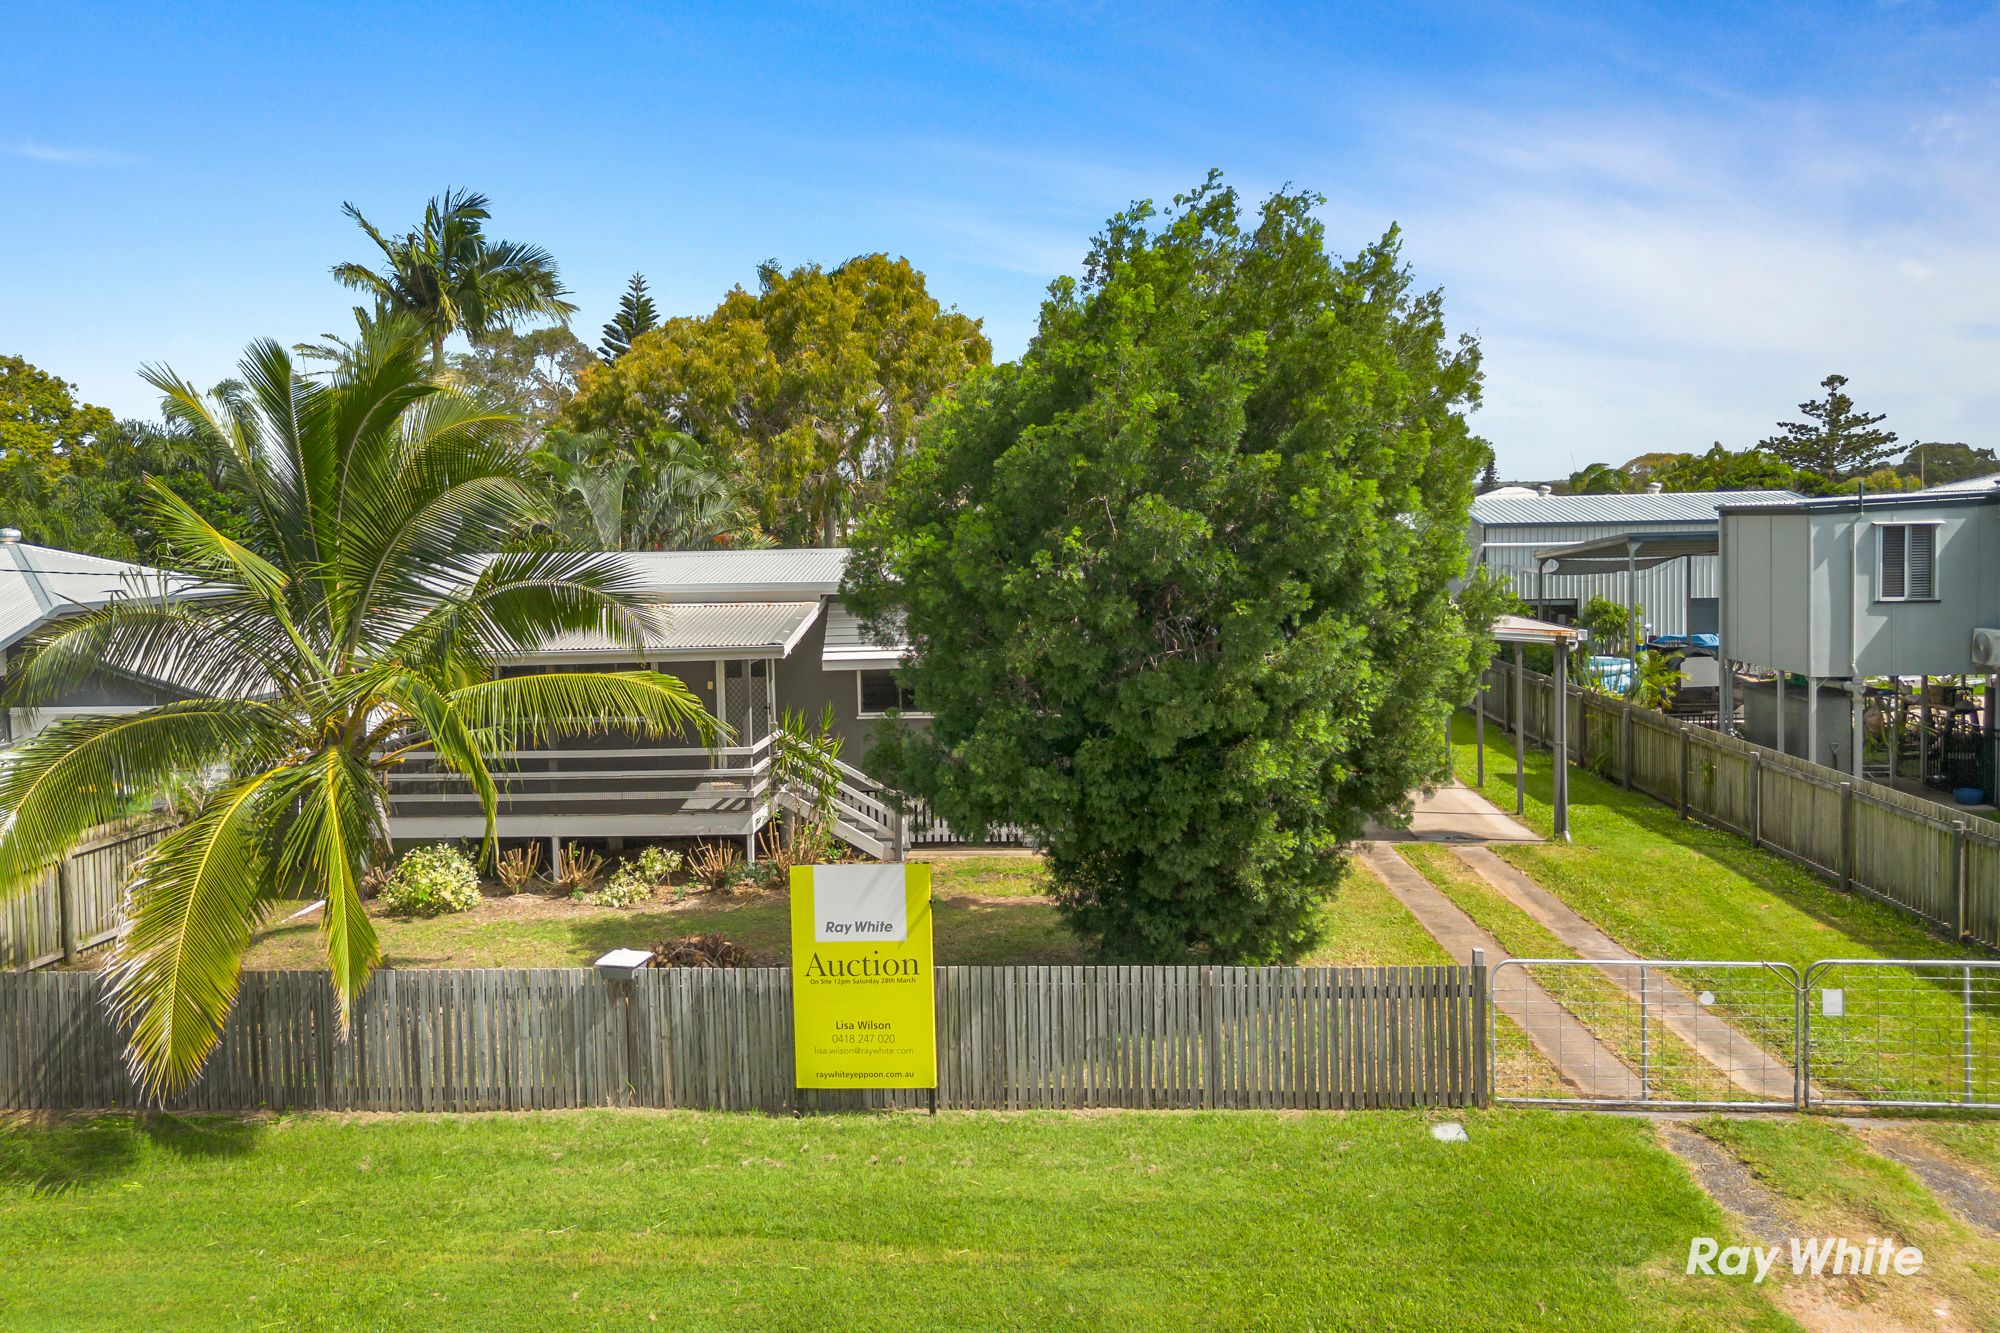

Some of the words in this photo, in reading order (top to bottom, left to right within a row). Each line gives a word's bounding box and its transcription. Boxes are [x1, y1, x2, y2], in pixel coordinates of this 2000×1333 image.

[826, 921, 852, 934] Ray
[855, 921, 893, 933] White
[805, 950, 920, 977] Auction
[834, 978, 851, 986] 12pm
[852, 978, 880, 986] Saturday
[835, 1021, 854, 1030] Lisa
[857, 1021, 891, 1030] Wilson
[832, 1034, 855, 1044] 0418
[858, 1034, 875, 1044] 247
[877, 1034, 896, 1044] 020
[814, 1047, 914, 1056] lisa.wilson@raywhite.com
[816, 1071, 915, 1079] raywhiteyeppoon.com.au
